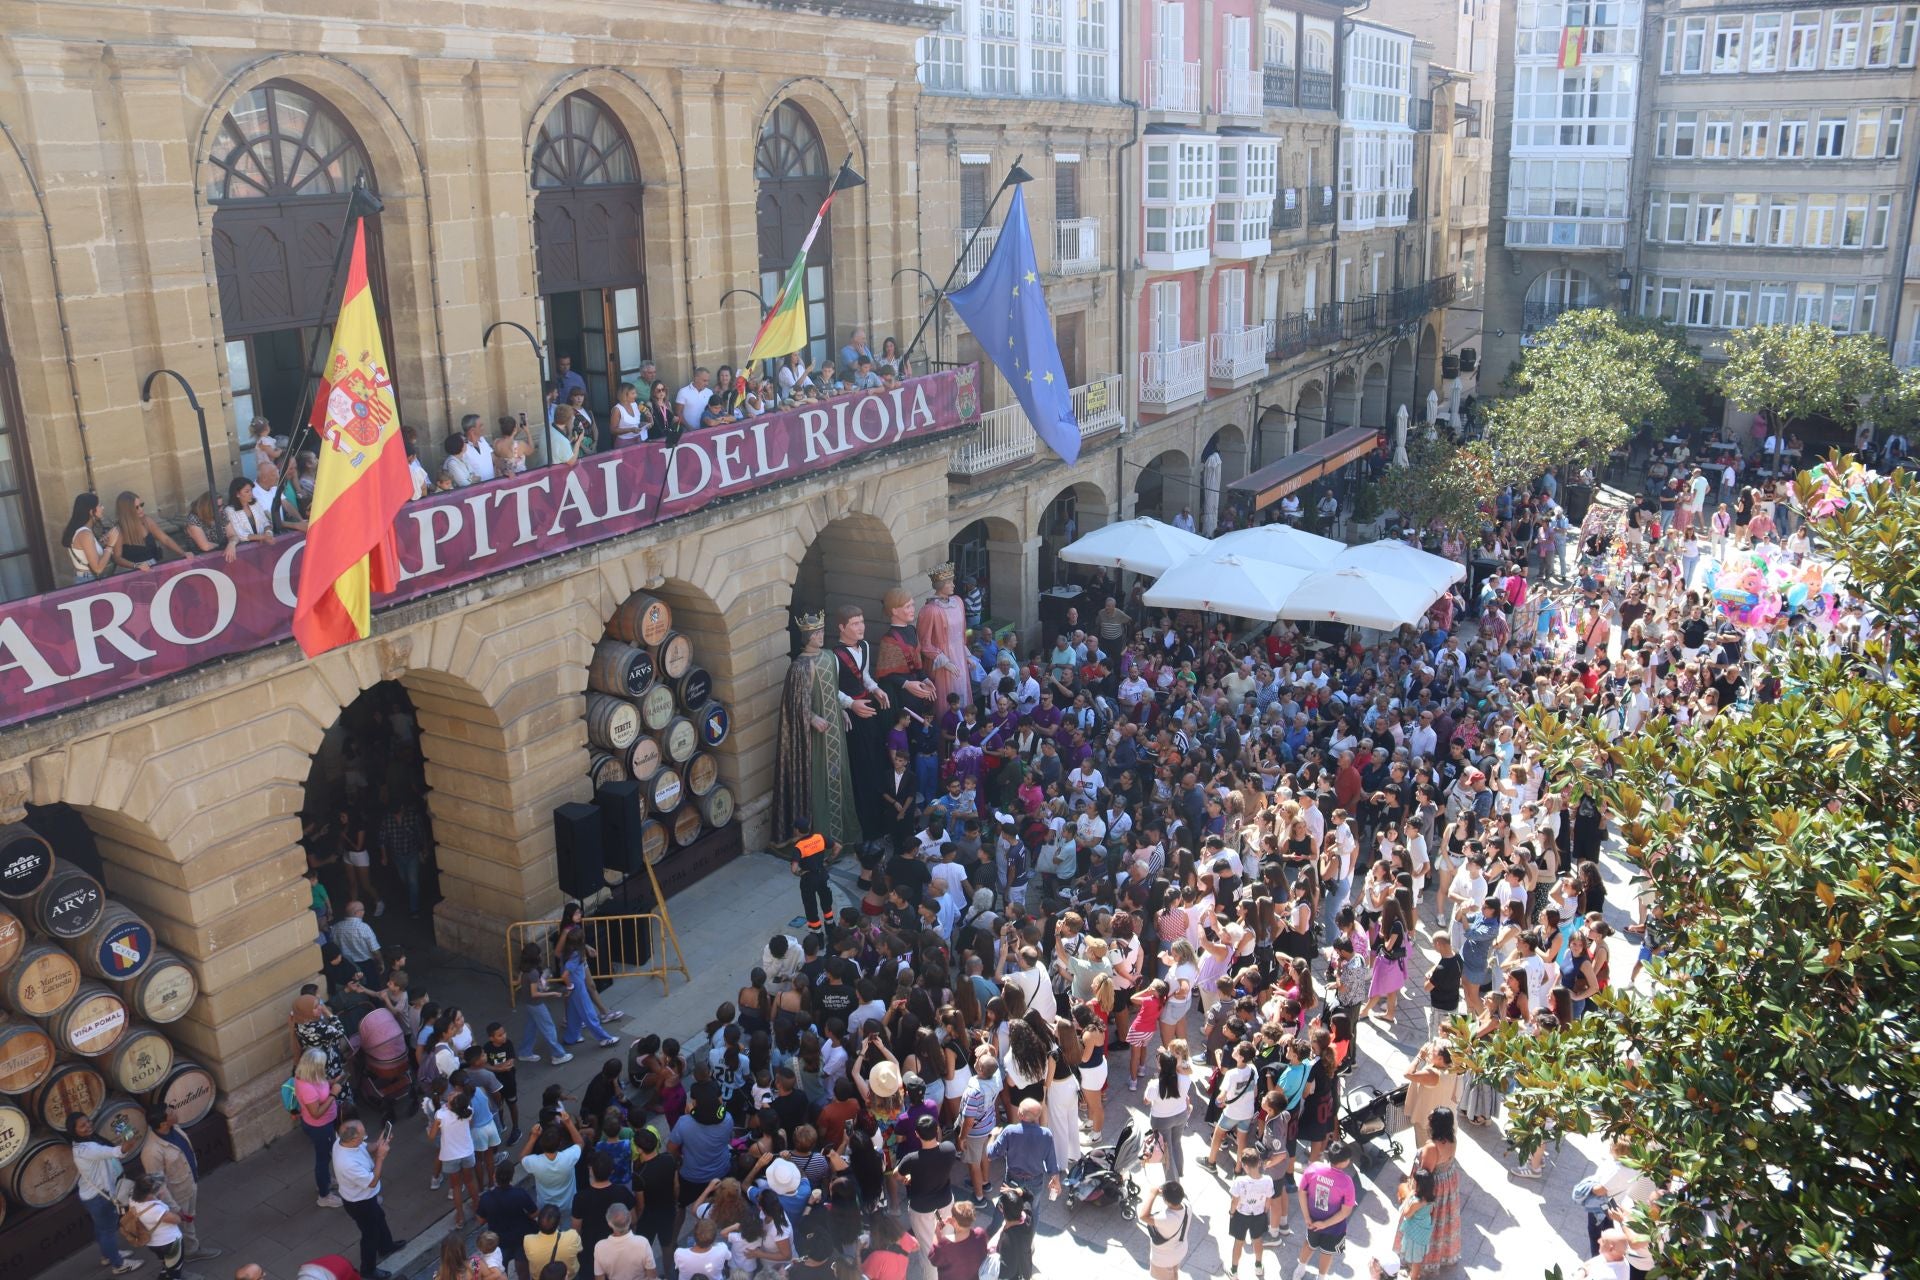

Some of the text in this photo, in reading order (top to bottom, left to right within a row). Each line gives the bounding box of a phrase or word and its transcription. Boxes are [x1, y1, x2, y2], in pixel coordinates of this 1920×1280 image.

[659, 422, 789, 503] DEL
[799, 383, 937, 464] RIOJA
[1280, 478, 1302, 497] TORMO
[629, 665, 652, 681] ARVS
[4, 857, 41, 878] MASET
[52, 889, 97, 918] ARVS
[74, 1012, 122, 1038] VIÑA POMAL
[131, 1064, 162, 1085] RODA
[167, 1086, 210, 1110] Santalba
[1317, 1175, 1335, 1187] KROOS
